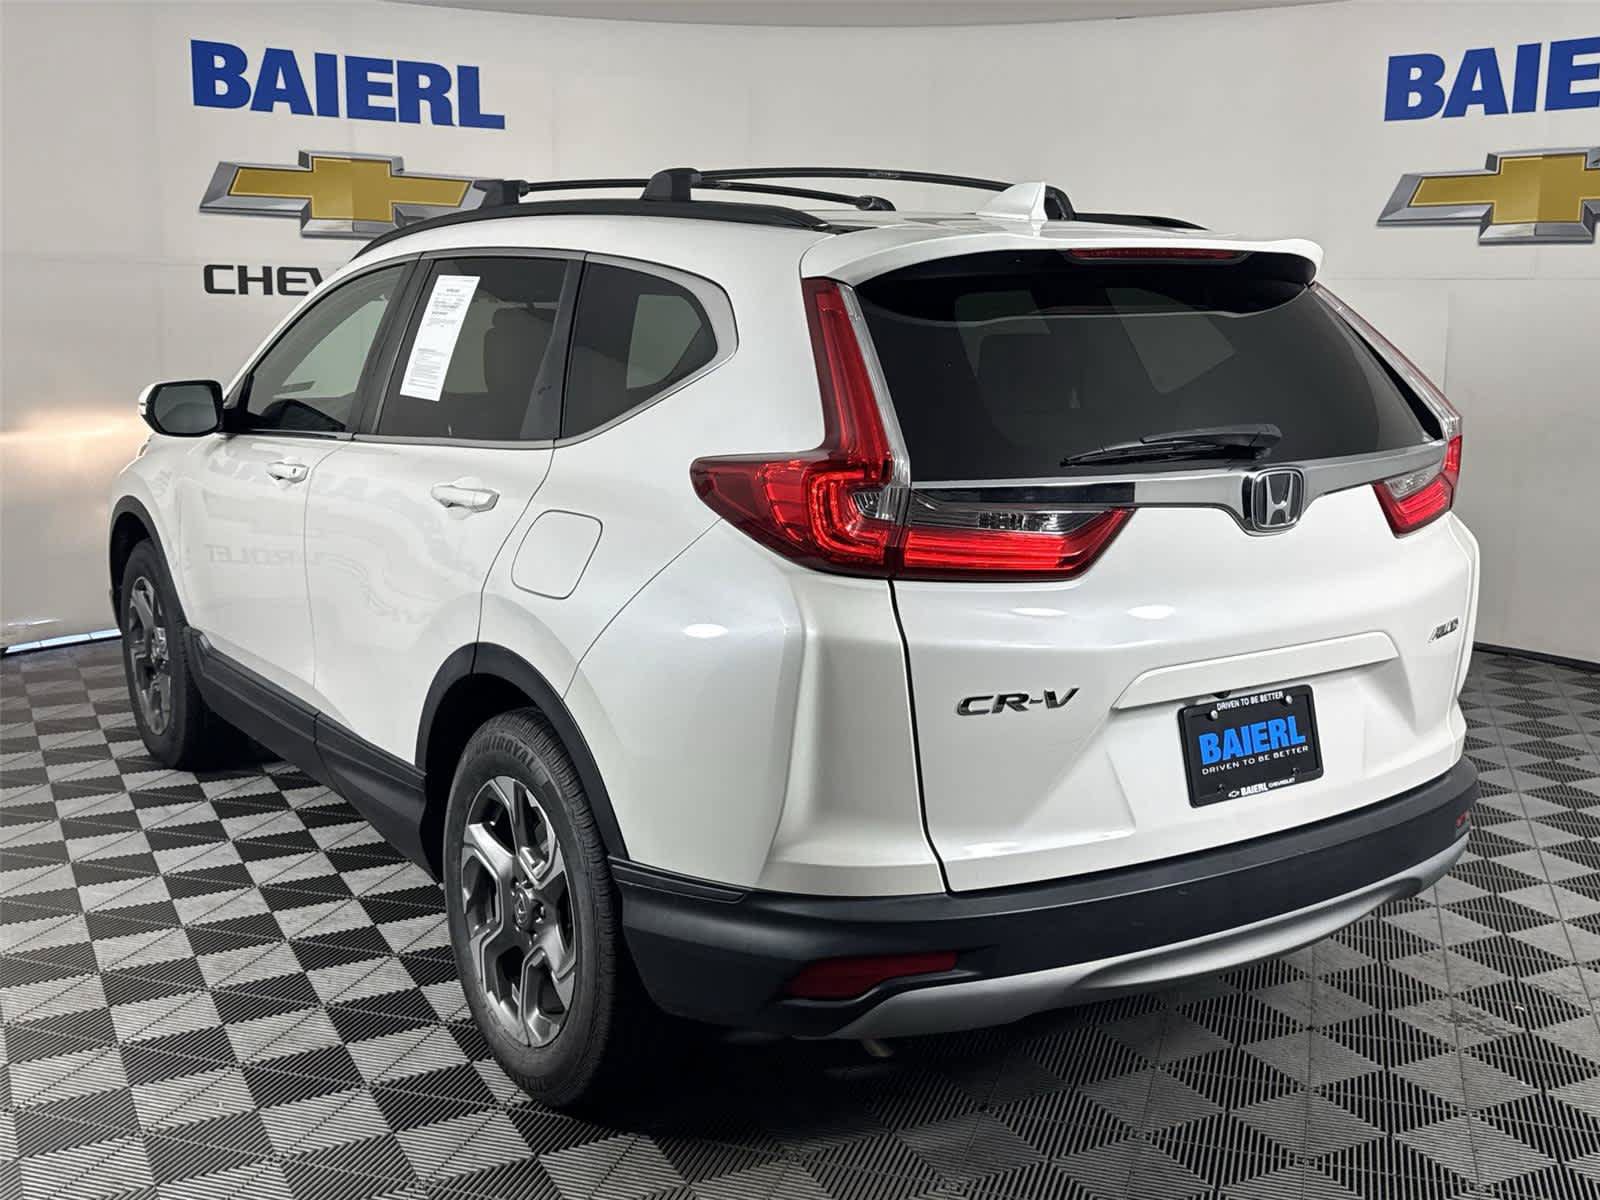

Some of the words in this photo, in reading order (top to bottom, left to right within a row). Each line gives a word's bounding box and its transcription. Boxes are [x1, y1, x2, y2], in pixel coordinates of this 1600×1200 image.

[190, 39, 505, 129] BAIERL
[1384, 36, 1600, 121] BAIE
[957, 687, 1080, 716] CR-V
[1217, 701, 1240, 711] DRIVEN
[1240, 698, 1250, 706] TO
[1250, 695, 1259, 704] BE
[1260, 691, 1284, 702] BETTER
[1198, 715, 1306, 765] BAIERL
[1202, 760, 1240, 775] DRIVEN
[1243, 757, 1256, 767] TO
[1258, 753, 1271, 762] BE
[1273, 745, 1309, 759] BETTER
[1240, 782, 1268, 796] BAIERL
